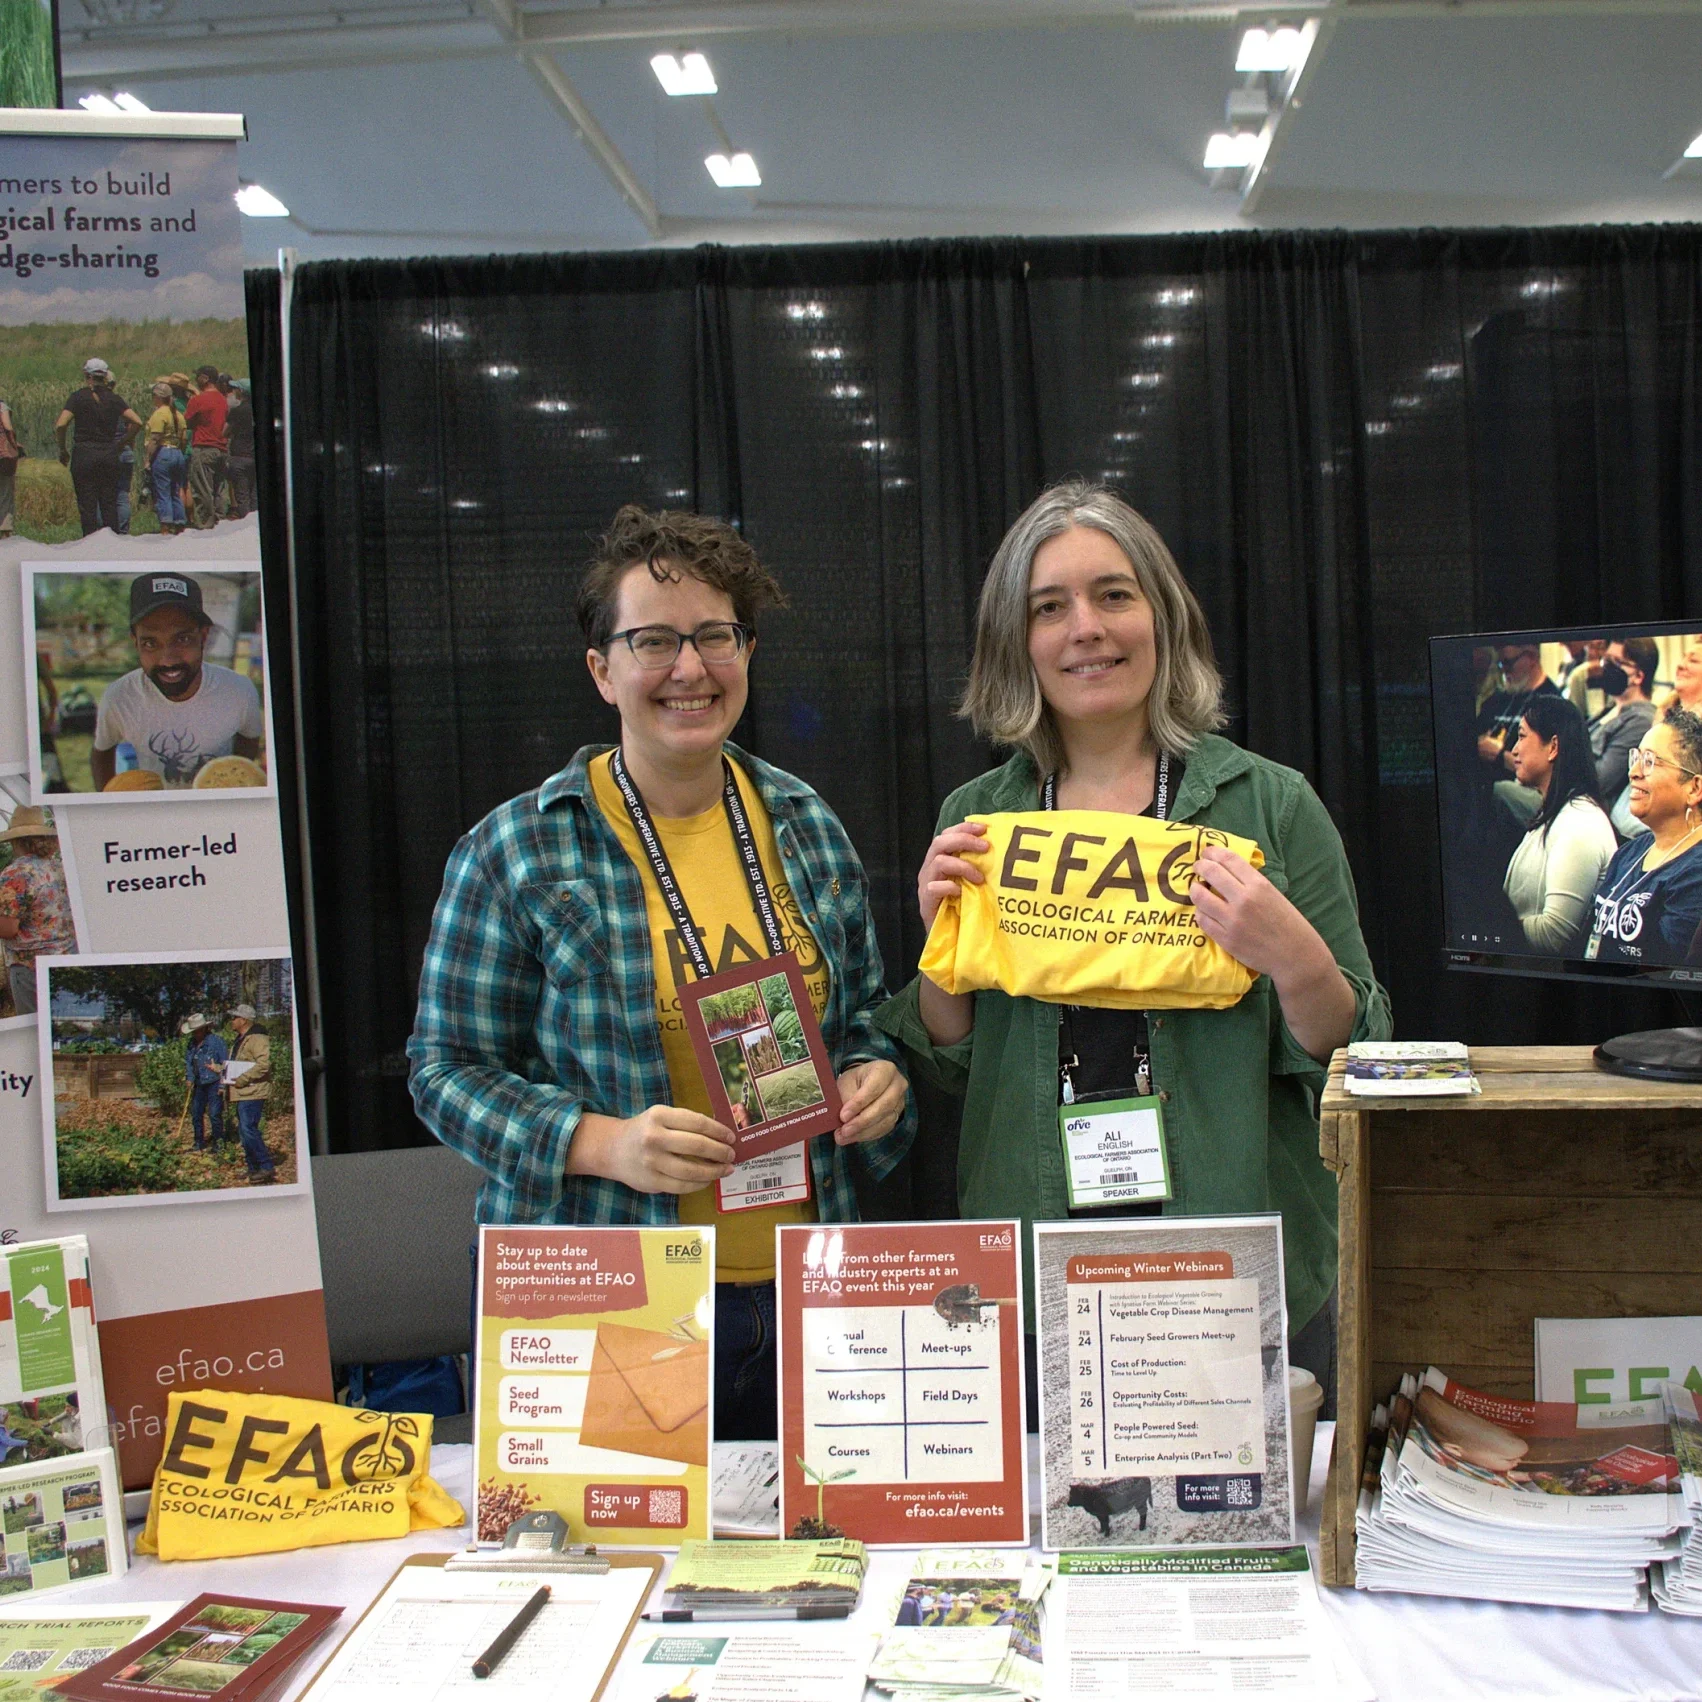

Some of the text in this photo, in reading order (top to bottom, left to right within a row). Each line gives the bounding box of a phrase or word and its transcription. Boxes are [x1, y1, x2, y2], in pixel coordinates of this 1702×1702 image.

[72, 176, 98, 194] to
[107, 171, 170, 196] build
[64, 207, 142, 232] farms
[150, 209, 196, 232] and
[617, 773, 639, 807] GROWERS
[633, 807, 661, 860] CO-OPERATIVE
[104, 833, 237, 863] Farmer-led
[654, 858, 665, 876] LTD.
[107, 865, 206, 893] research
[661, 875, 673, 893] EST.
[998, 896, 1199, 928] ECOLOGICAL FARMER
[678, 916, 687, 924] A
[999, 918, 1207, 948] ASSOCIATION OF ONTARIO
[681, 923, 703, 963] TRADITION
[698, 962, 709, 976] OF
[741, 1133, 755, 1142] GOOD
[755, 1128, 769, 1137] FOOD
[770, 1122, 786, 1132] COMES
[787, 1117, 801, 1126] FROM
[801, 1112, 816, 1120] GOOD
[1067, 1120, 1091, 1131] ofvc
[1104, 1131, 1121, 1142] ALI
[1098, 1140, 1133, 1151] ENGLISH
[745, 1191, 785, 1204] EXHIBITOR
[1103, 1188, 1139, 1198] SPEAKER
[979, 1234, 1012, 1246] EFAO
[496, 1243, 588, 1262] Stay up to date
[666, 1245, 702, 1257] EFAO
[841, 1252, 869, 1264] from
[873, 1251, 905, 1264] other
[908, 1251, 955, 1263] farmers
[31, 1264, 50, 1274] 2024
[496, 1258, 598, 1271] about events and
[1076, 1261, 1224, 1279] Upcoming Winter Webinars
[802, 1267, 959, 1281] and experts at an
[496, 1273, 636, 1290] opportunities at EFAO
[803, 1279, 934, 1296] EFAO event this year
[495, 1290, 607, 1305] Sign up for a newsletter
[1109, 1293, 1140, 1301] Introduction
[1148, 1292, 1174, 1301] Ecological
[1175, 1292, 1200, 1300] Vegetable
[1201, 1291, 1222, 1299] Growing
[1077, 1304, 1091, 1314] 24
[1110, 1306, 1254, 1320] Vegetable Crop Disease Management
[511, 1337, 551, 1350] EFAO
[1078, 1336, 1091, 1347] 24
[1110, 1331, 1236, 1344] February Seed Growers Meet-up
[922, 1342, 972, 1356] Meet-ups
[510, 1351, 578, 1364] Newsletter
[1111, 1358, 1186, 1368] Cost of Production:
[156, 1348, 285, 1386] efao.ca
[1079, 1365, 1092, 1376] 25
[509, 1386, 539, 1399] Seed
[828, 1390, 886, 1404] Workshops
[923, 1391, 978, 1404] Field Days
[1113, 1390, 1188, 1402] Opportunity Costs:
[1080, 1397, 1093, 1408] 26
[1456, 1389, 1535, 1412] Ecological
[509, 1401, 562, 1418] Program
[1473, 1408, 1534, 1424] Ontario
[1084, 1429, 1091, 1439] 4
[1114, 1422, 1199, 1434] People Powered Seed:
[162, 1400, 415, 1490] EFAO
[508, 1438, 543, 1451] Small
[828, 1446, 870, 1456] Courses
[924, 1444, 973, 1455] Webinars
[508, 1452, 549, 1466] Grains
[1084, 1456, 1091, 1466] 5
[1115, 1450, 1232, 1464] Enterprise Analysis (Part Two)
[32, 1471, 95, 1488] RESEARCH PROGRAM
[591, 1490, 640, 1510] Sign up
[886, 1491, 968, 1502] For more info visit:
[160, 1499, 395, 1523] SSOCIATION OF ONTARIO
[591, 1508, 617, 1519] now
[905, 1503, 1005, 1518] efao.ca/events
[1069, 1556, 1279, 1567] Genetically Modified Fruits
[1069, 1562, 1272, 1574] and Vegetables in Canada
[79, 1618, 144, 1628] REPORTS
